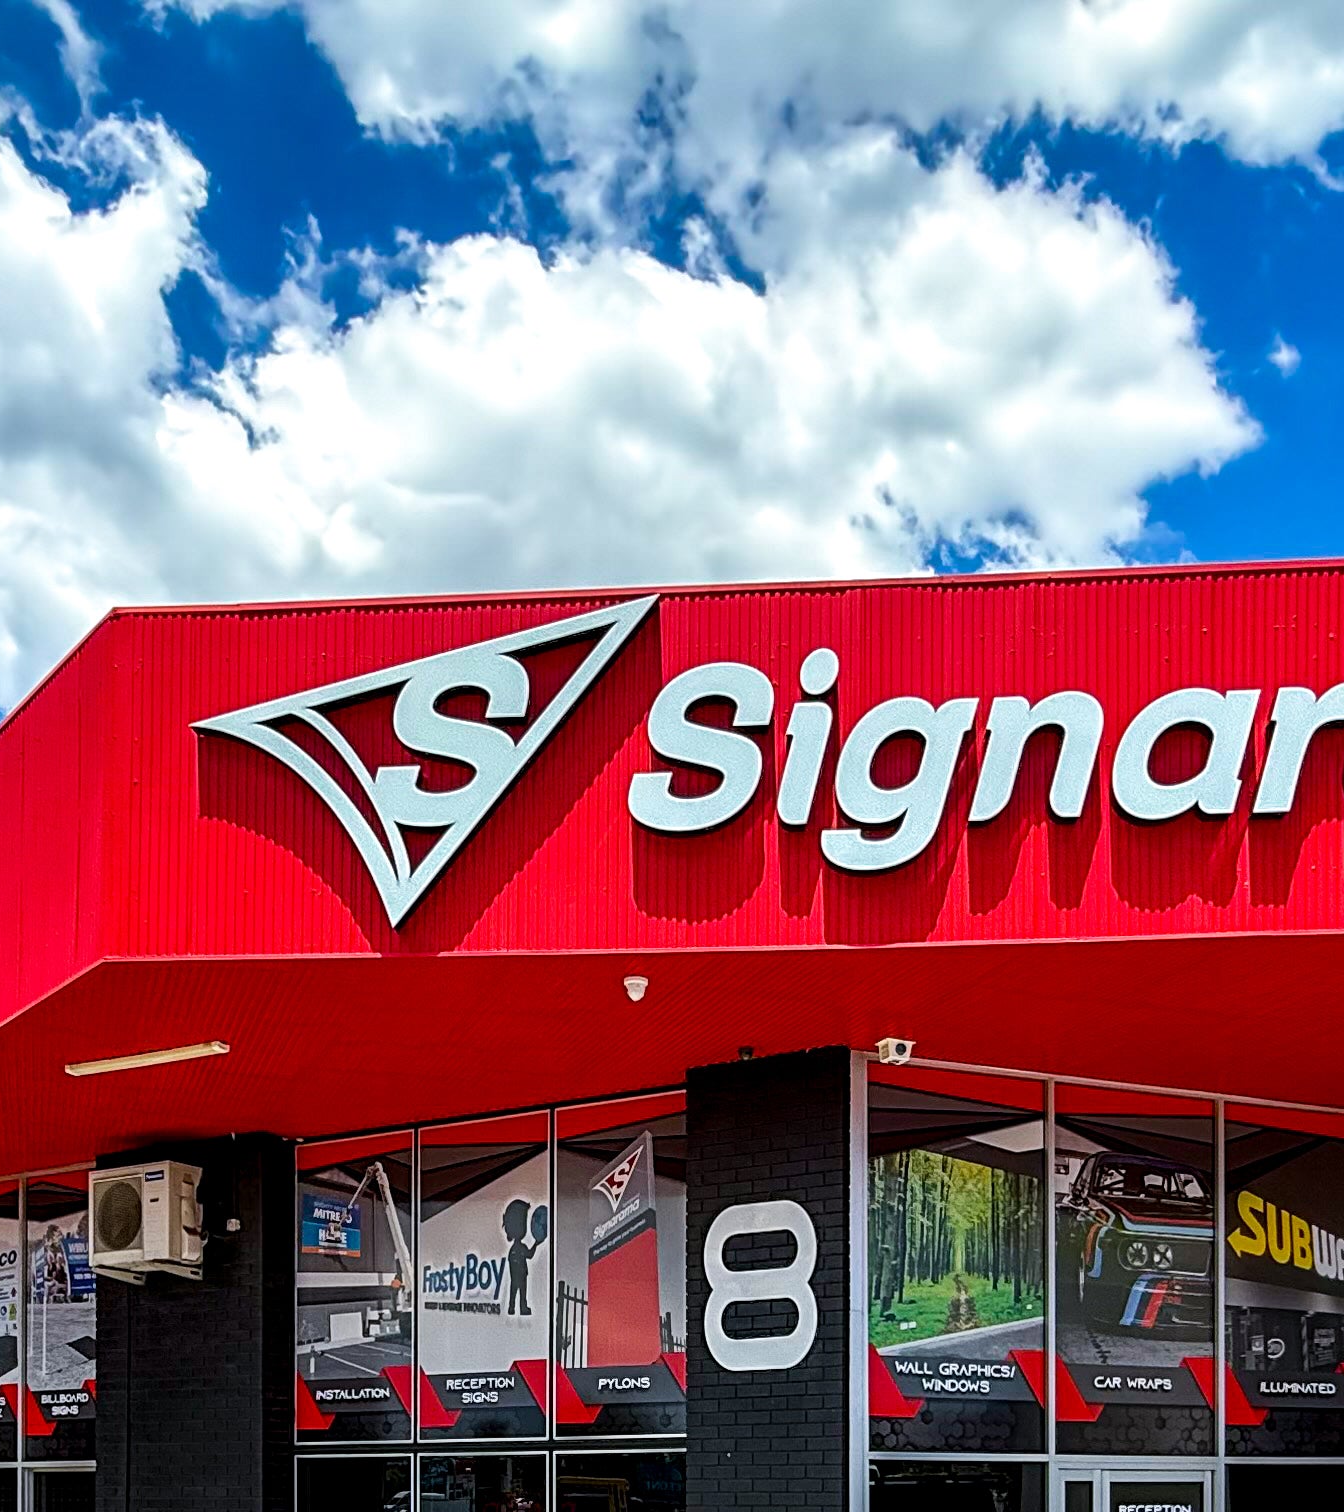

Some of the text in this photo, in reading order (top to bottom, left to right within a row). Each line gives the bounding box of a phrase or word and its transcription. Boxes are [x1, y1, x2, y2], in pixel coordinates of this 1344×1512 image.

[593, 1199, 640, 1240] Signarama
[704, 1200, 818, 1371] 8
[895, 1361, 1015, 1377] WALL GRAPHICS/
[447, 1377, 514, 1390] RECEPTION
[598, 1377, 650, 1389] PYLONS
[922, 1379, 989, 1392] WINDOWS
[1094, 1376, 1172, 1389] CAR WRAPS
[1261, 1382, 1335, 1394] ILLUMINATED
[41, 1394, 89, 1404] BILLBOARD
[316, 1388, 390, 1400] INSTALLATION
[462, 1392, 498, 1403] SIGNS
[51, 1406, 78, 1416] SIGNS
